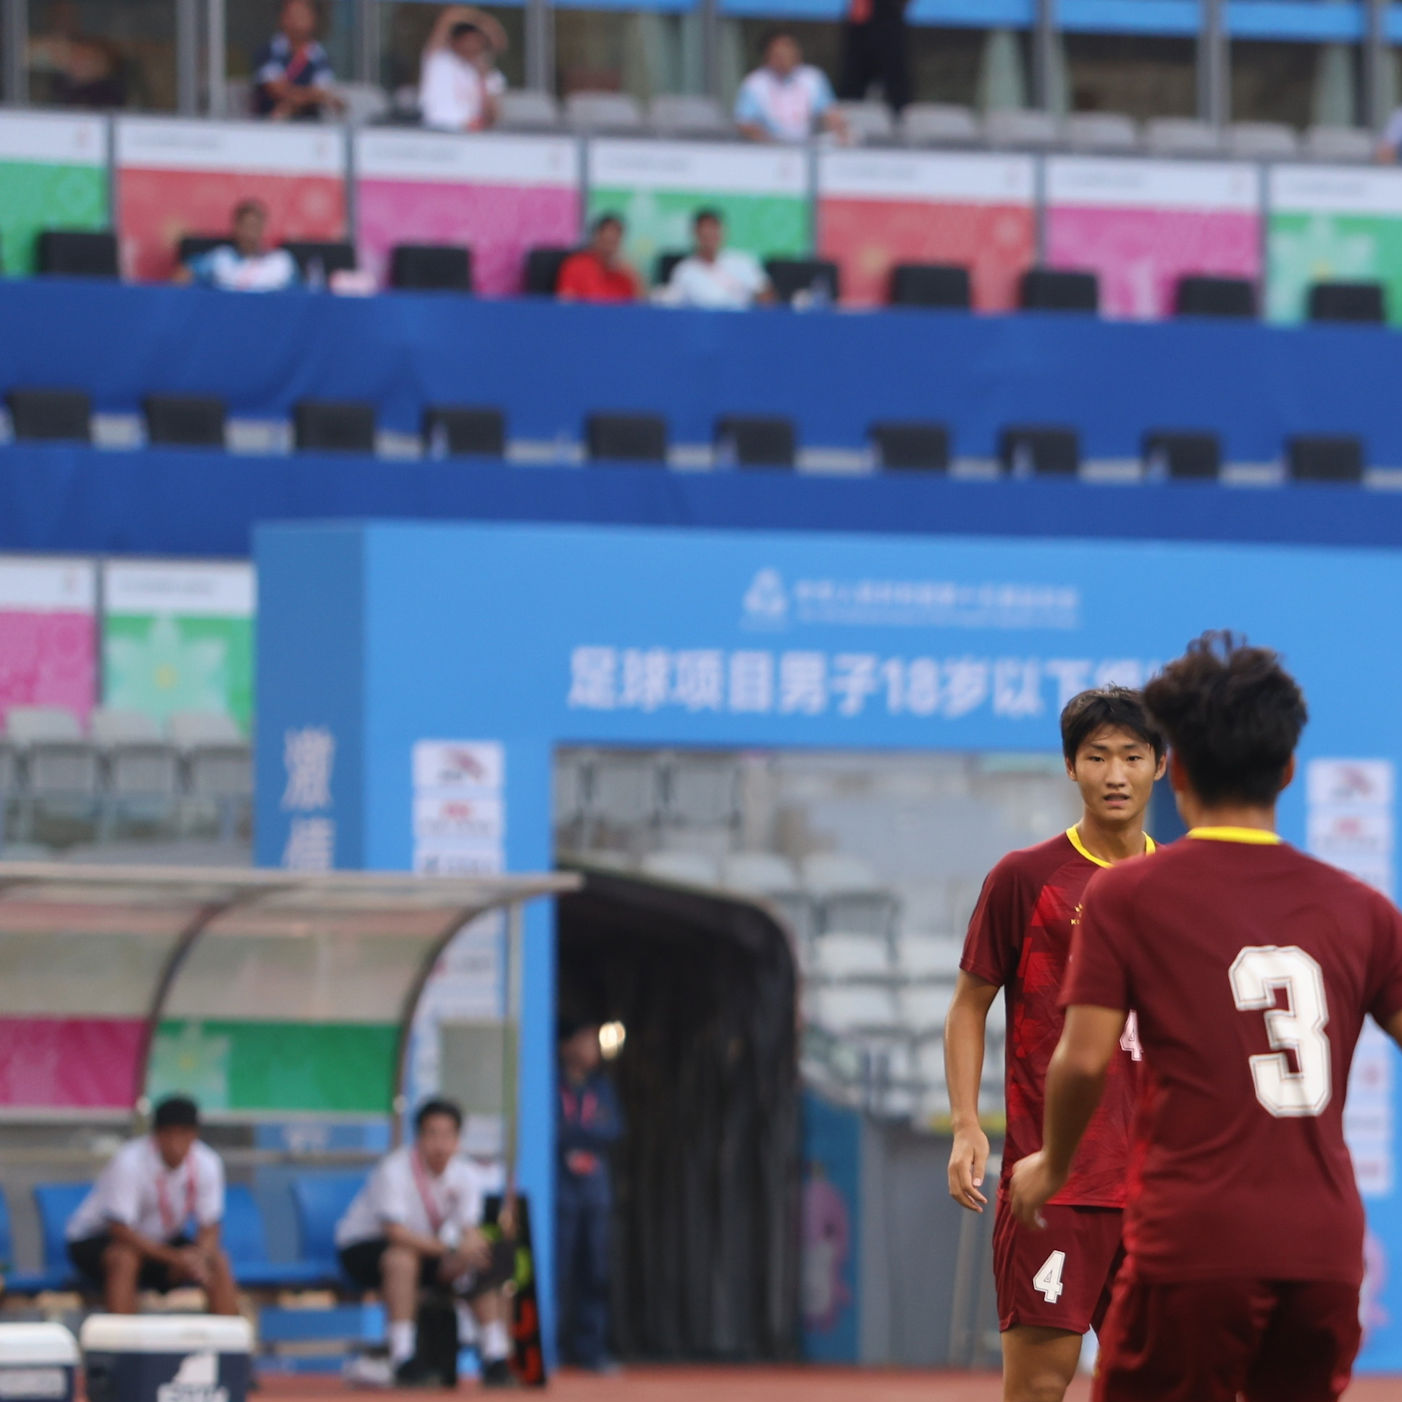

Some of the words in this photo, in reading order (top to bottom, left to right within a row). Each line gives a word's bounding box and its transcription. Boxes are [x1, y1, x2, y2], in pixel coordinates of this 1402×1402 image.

[1119, 1008, 1144, 1062] 4
[1228, 945, 1332, 1118] 3
[1032, 1249, 1066, 1304] 4
